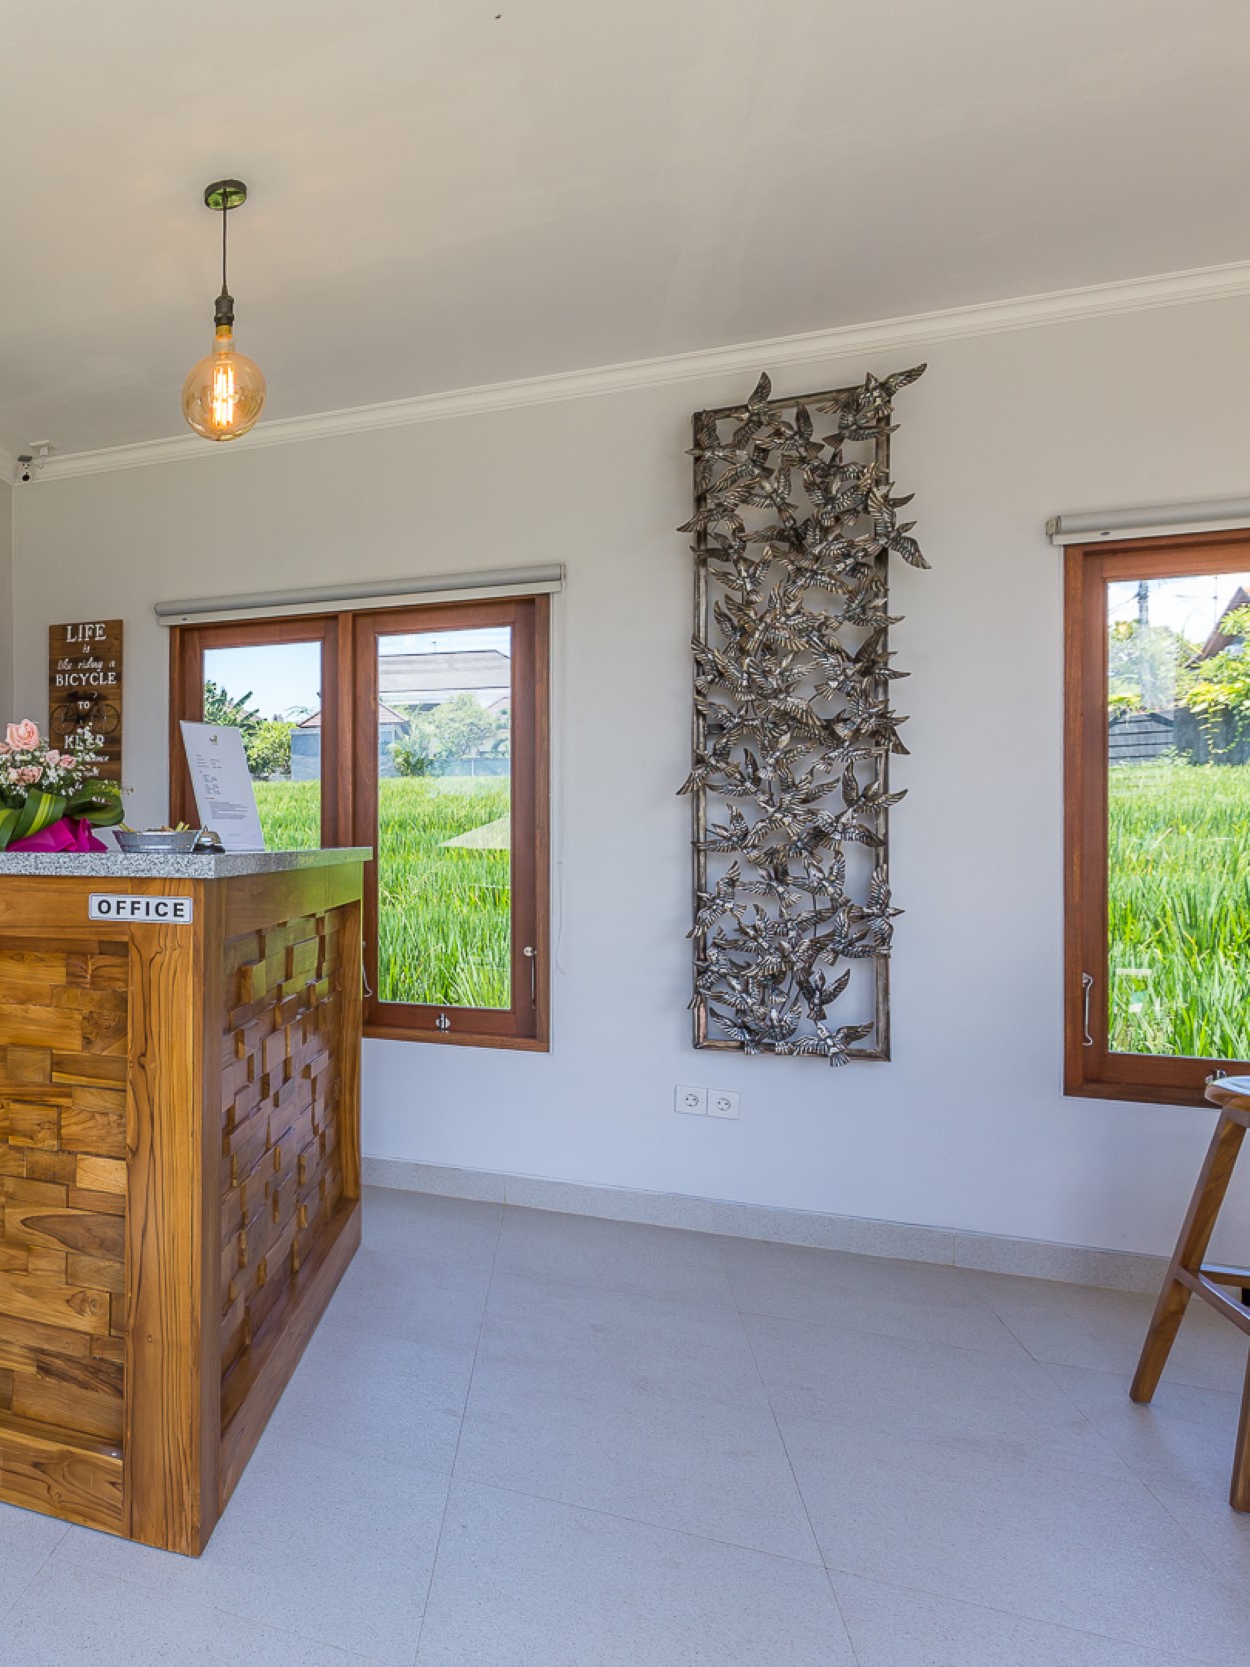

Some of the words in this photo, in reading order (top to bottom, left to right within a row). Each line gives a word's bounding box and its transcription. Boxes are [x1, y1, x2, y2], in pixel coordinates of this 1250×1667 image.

[65, 623, 107, 643] LIFE
[77, 657, 104, 672] riding
[55, 672, 118, 687] BICYCLE
[77, 701, 90, 709] TO
[97, 899, 185, 918] OFFICE
